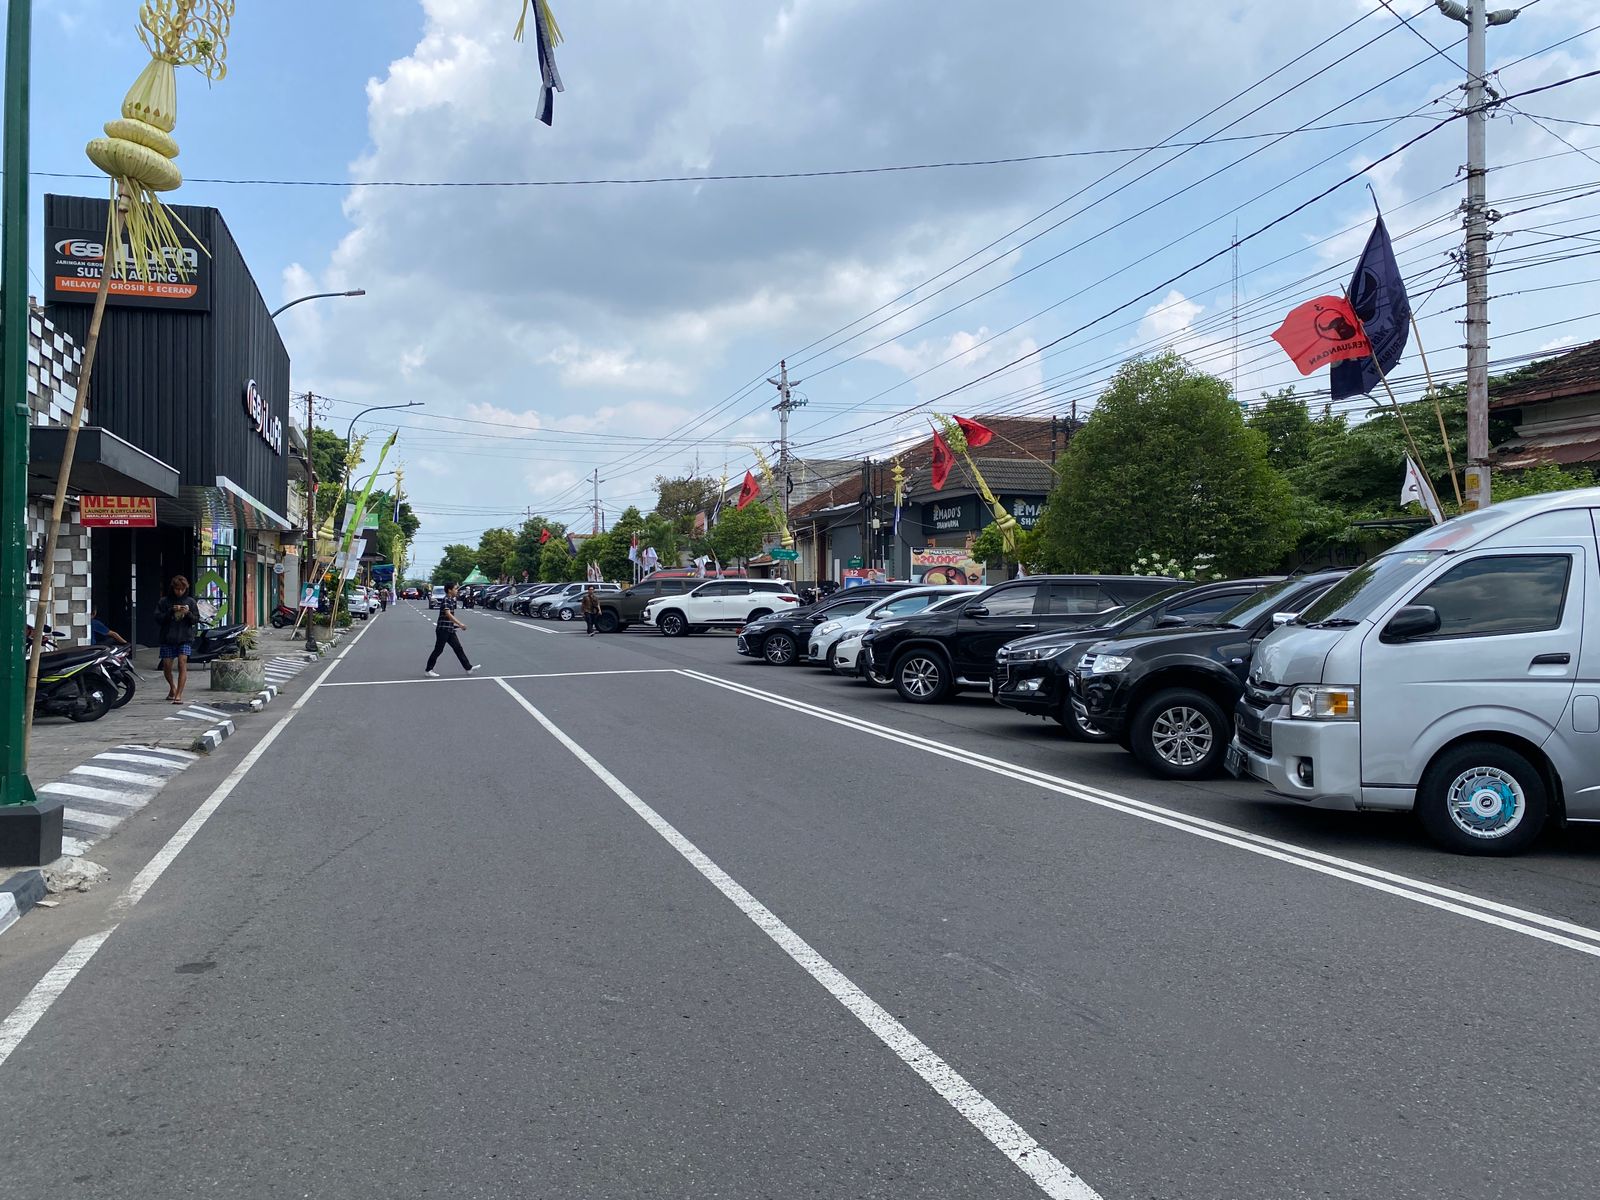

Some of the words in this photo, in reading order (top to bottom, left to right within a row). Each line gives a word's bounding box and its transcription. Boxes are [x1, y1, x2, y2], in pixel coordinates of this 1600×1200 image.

[55, 259, 86, 267] JARINGAN
[77, 267, 123, 280] SULAN
[61, 280, 101, 289] MELAYA
[111, 283, 145, 292] GROSIR
[156, 286, 192, 294] ECERAN
[84, 496, 151, 508] MELIA
